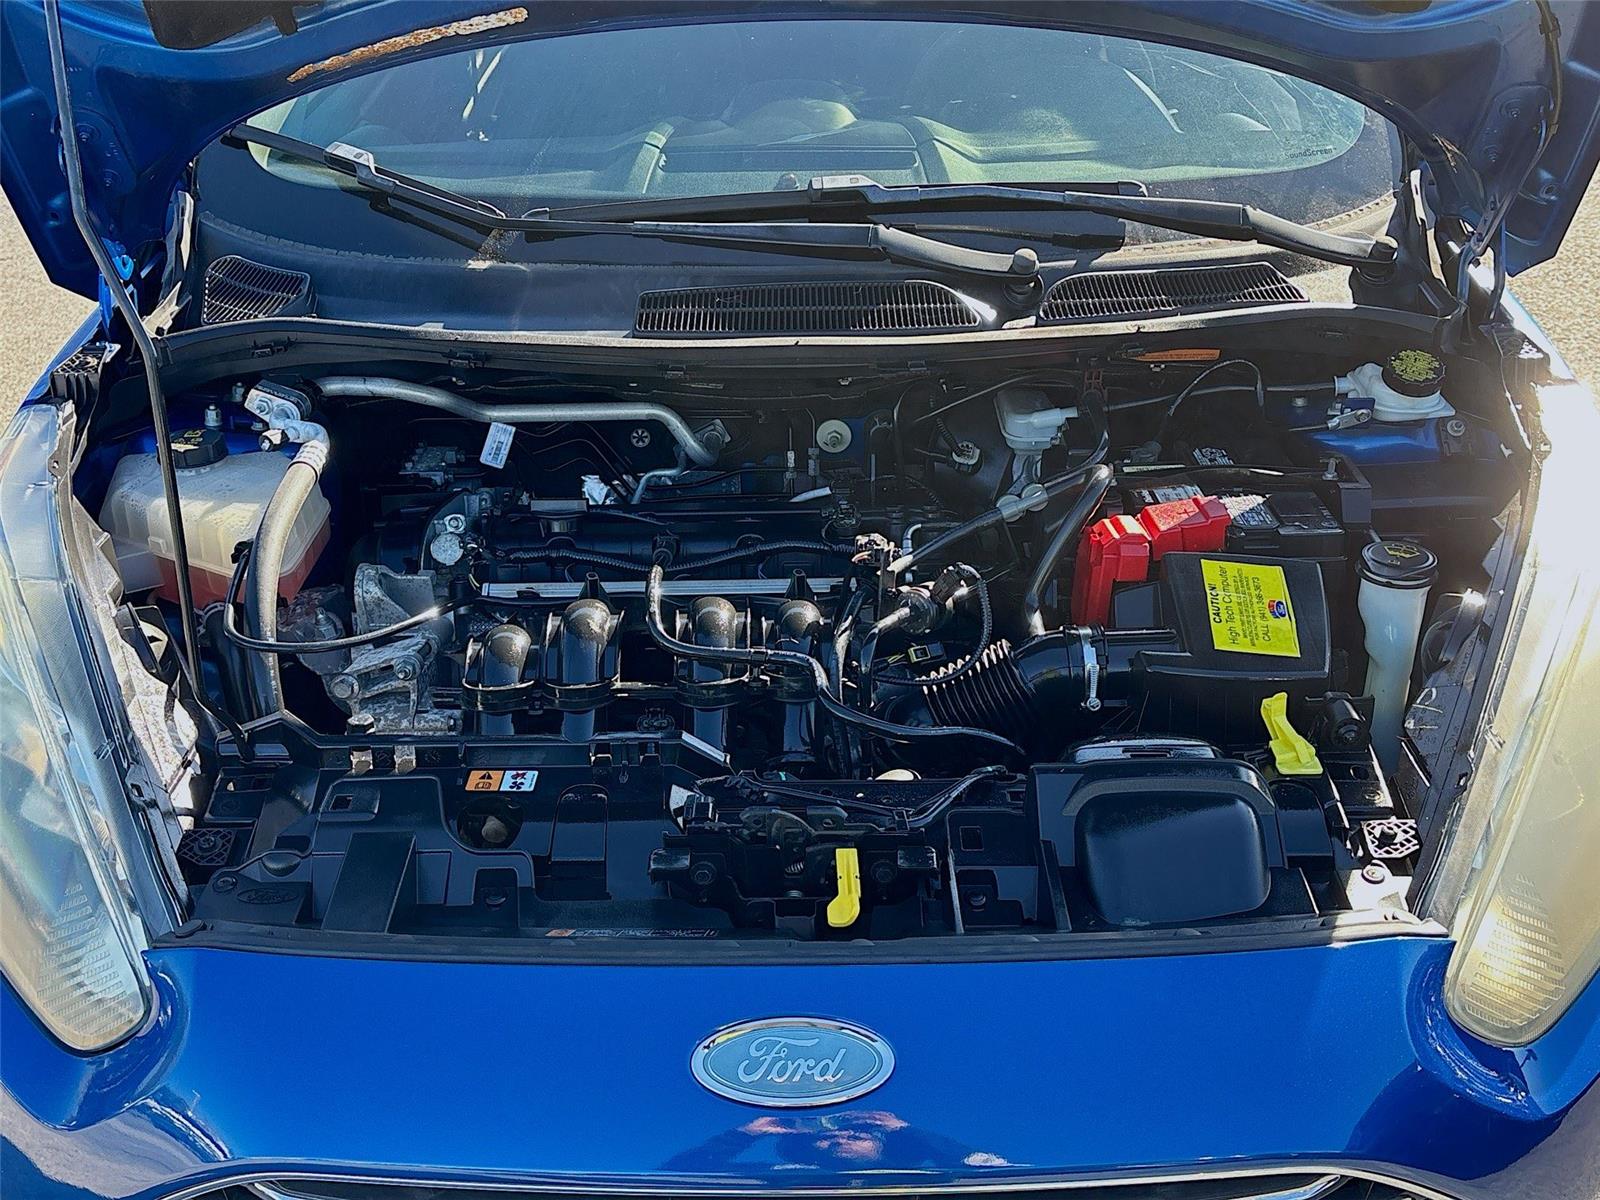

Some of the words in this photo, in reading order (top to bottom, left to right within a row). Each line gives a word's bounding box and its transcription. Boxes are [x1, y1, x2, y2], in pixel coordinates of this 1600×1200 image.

[1219, 566, 1233, 604] Computer
[1224, 605, 1235, 624] Tech
[1228, 626, 1240, 645] High
[1260, 624, 1271, 641] CALL
[737, 1036, 846, 1083] Ford
